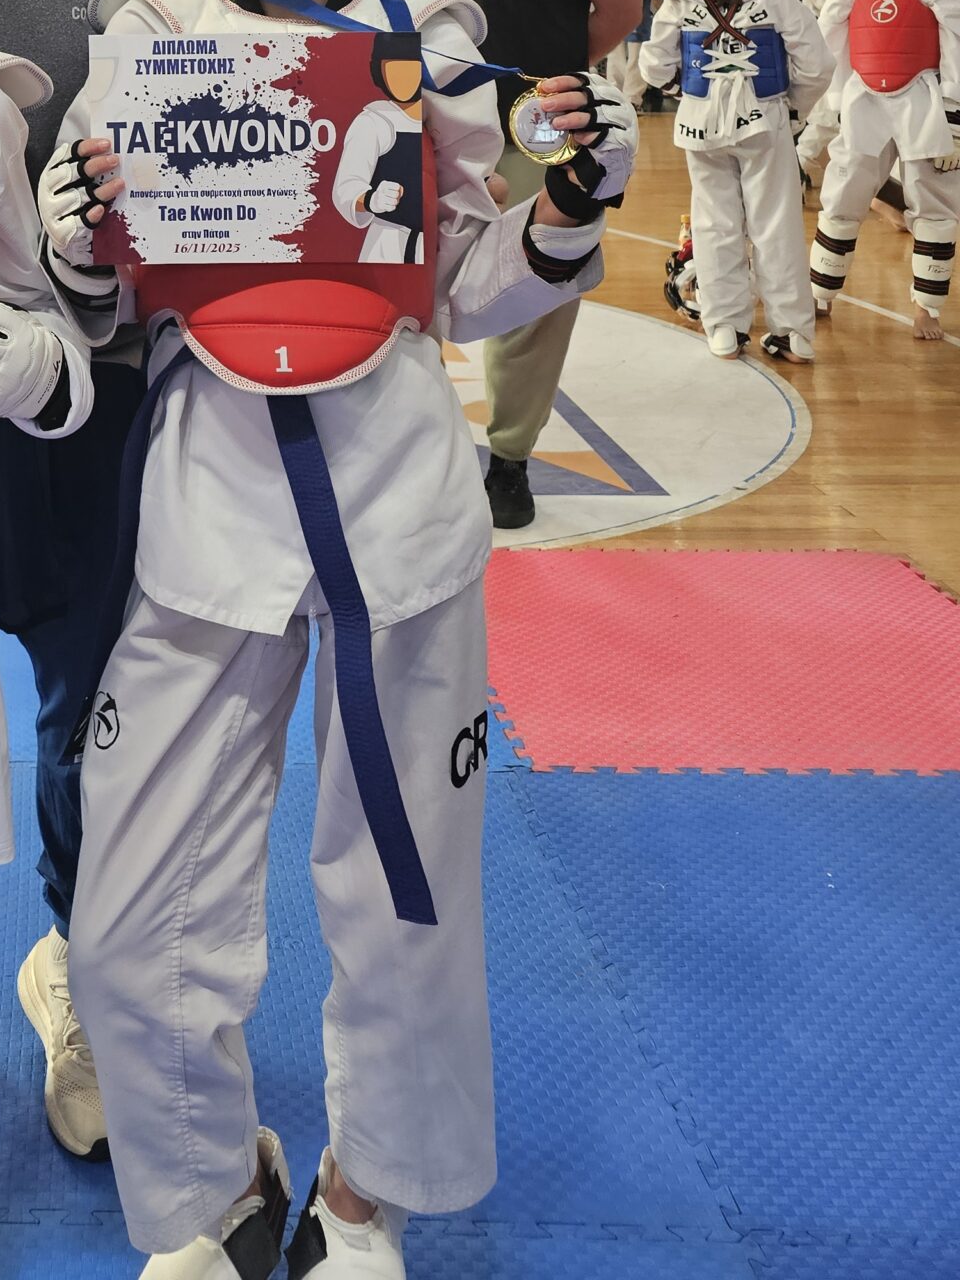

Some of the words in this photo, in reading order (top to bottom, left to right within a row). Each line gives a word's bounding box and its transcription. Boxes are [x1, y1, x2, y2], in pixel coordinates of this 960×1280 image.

[152, 39, 218, 55] ΔΙΠΛΩΜΑ
[135, 58, 235, 75] ΣΥΜΜΕΤΟΧΗΣ
[106, 118, 337, 154] TAEKWONDO
[243, 188, 266, 198] στους
[266, 187, 297, 198] Αγώνες
[158, 205, 187, 221] Tae
[190, 205, 233, 221] Kwon
[236, 204, 257, 221] Do
[181, 230, 202, 239] στην
[203, 228, 230, 239] Πάτρα
[174, 242, 241, 254] 16/11/2025
[274, 345, 293, 373] 1
